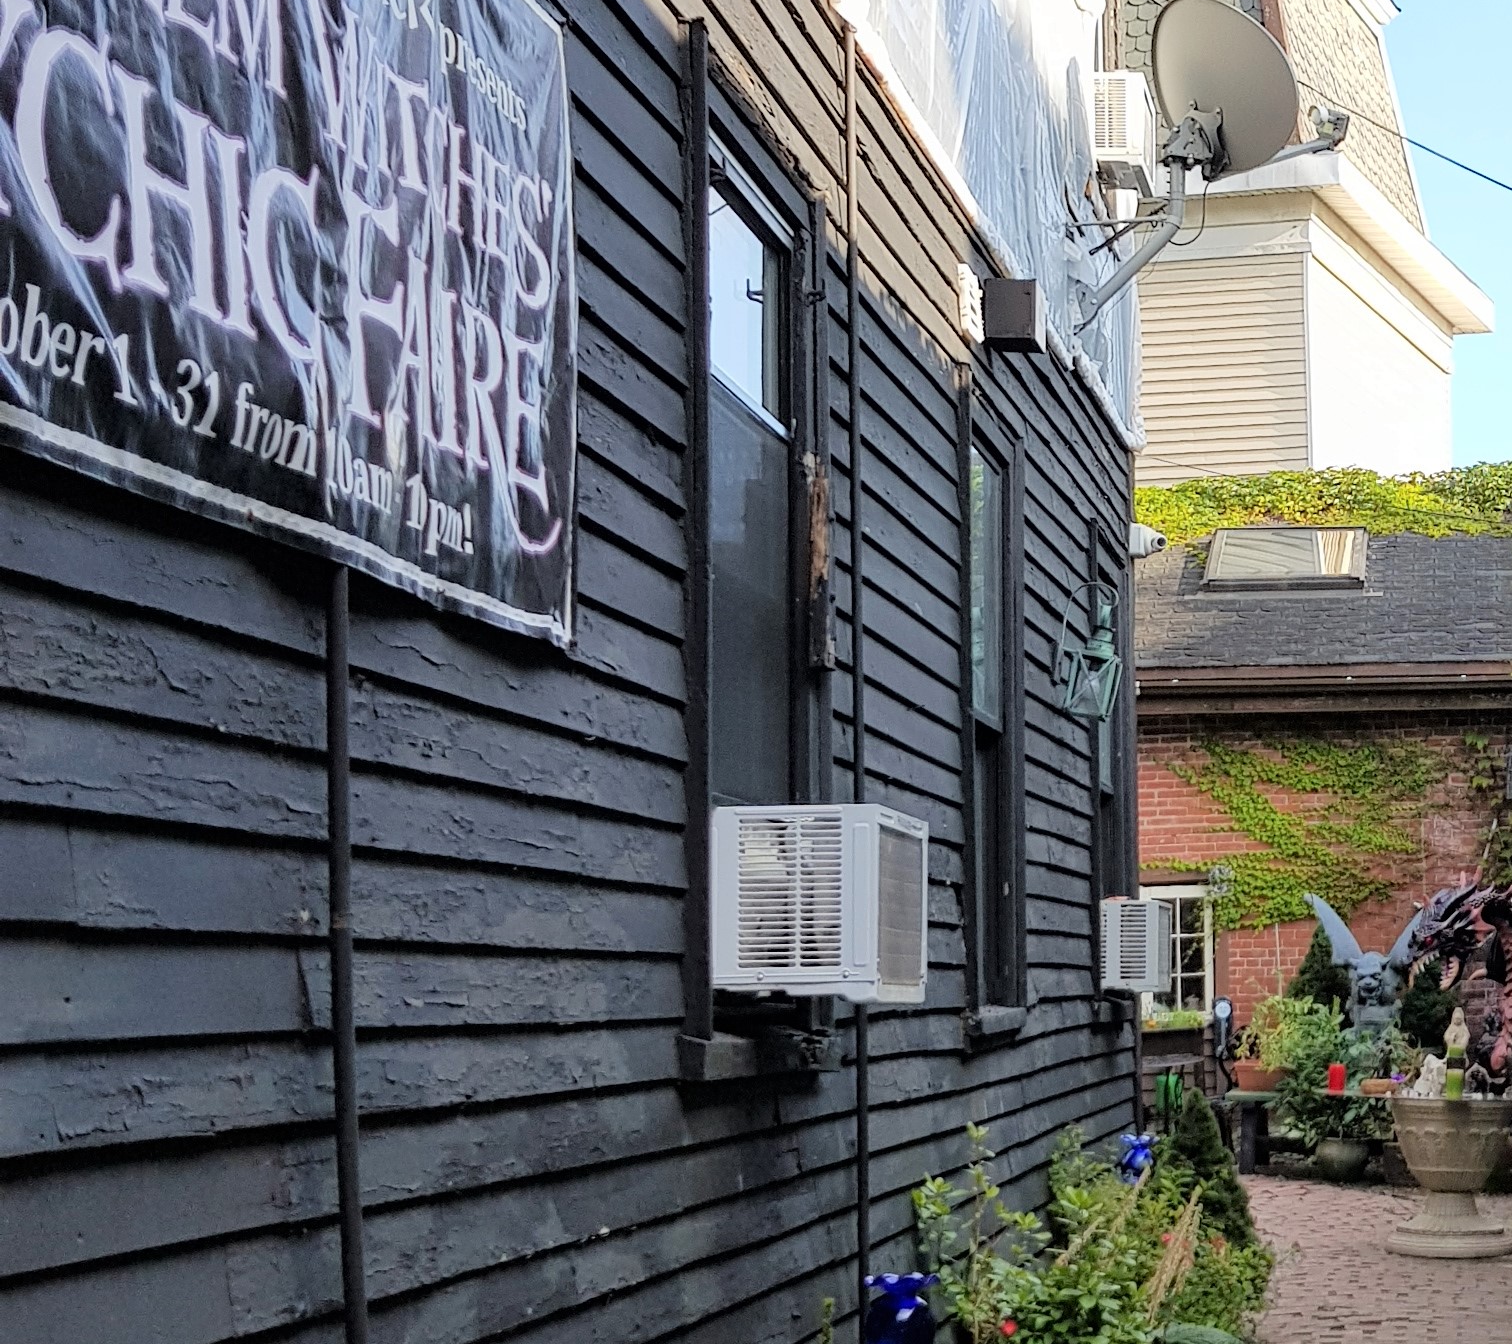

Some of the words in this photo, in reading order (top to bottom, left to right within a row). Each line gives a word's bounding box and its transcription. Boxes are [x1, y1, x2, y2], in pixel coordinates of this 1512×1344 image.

[440, 22, 528, 131] presents
[171, 358, 220, 438] 31
[230, 381, 317, 479] from
[345, 184, 560, 552] FAIRE
